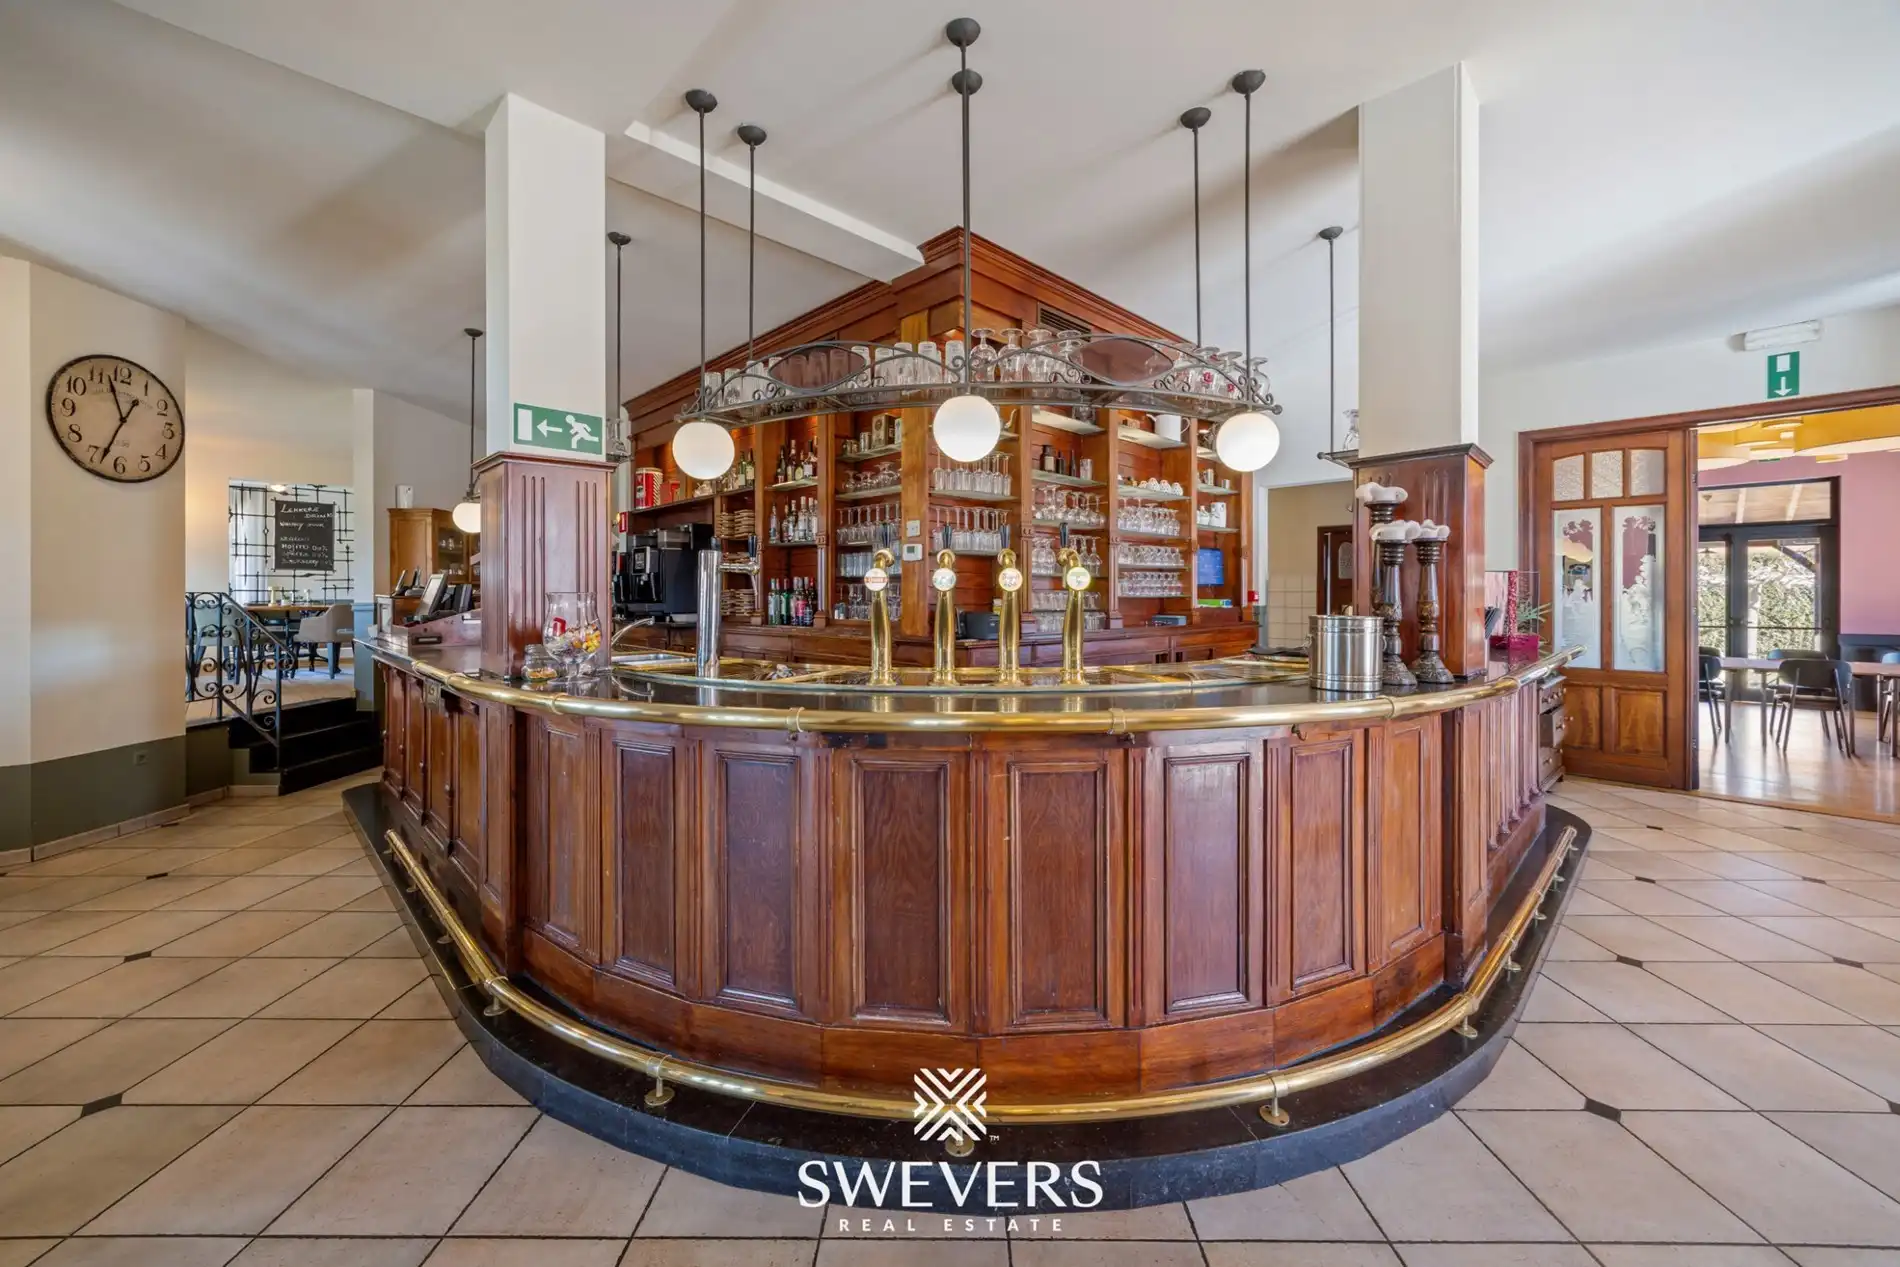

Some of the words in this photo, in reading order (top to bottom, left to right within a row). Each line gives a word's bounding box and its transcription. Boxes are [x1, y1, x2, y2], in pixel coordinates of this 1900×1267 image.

[88, 365, 104, 385] 11
[114, 365, 132, 386] 12
[66, 375, 87, 396] 10
[144, 379, 149, 397] 1
[61, 397, 76, 417] 9
[156, 399, 168, 417] 2
[68, 423, 83, 443] 8
[162, 421, 175, 440] 3
[86, 444, 100, 463] 7
[155, 443, 167, 460] 4
[113, 456, 127, 474] 6
[137, 454, 151, 472] 5
